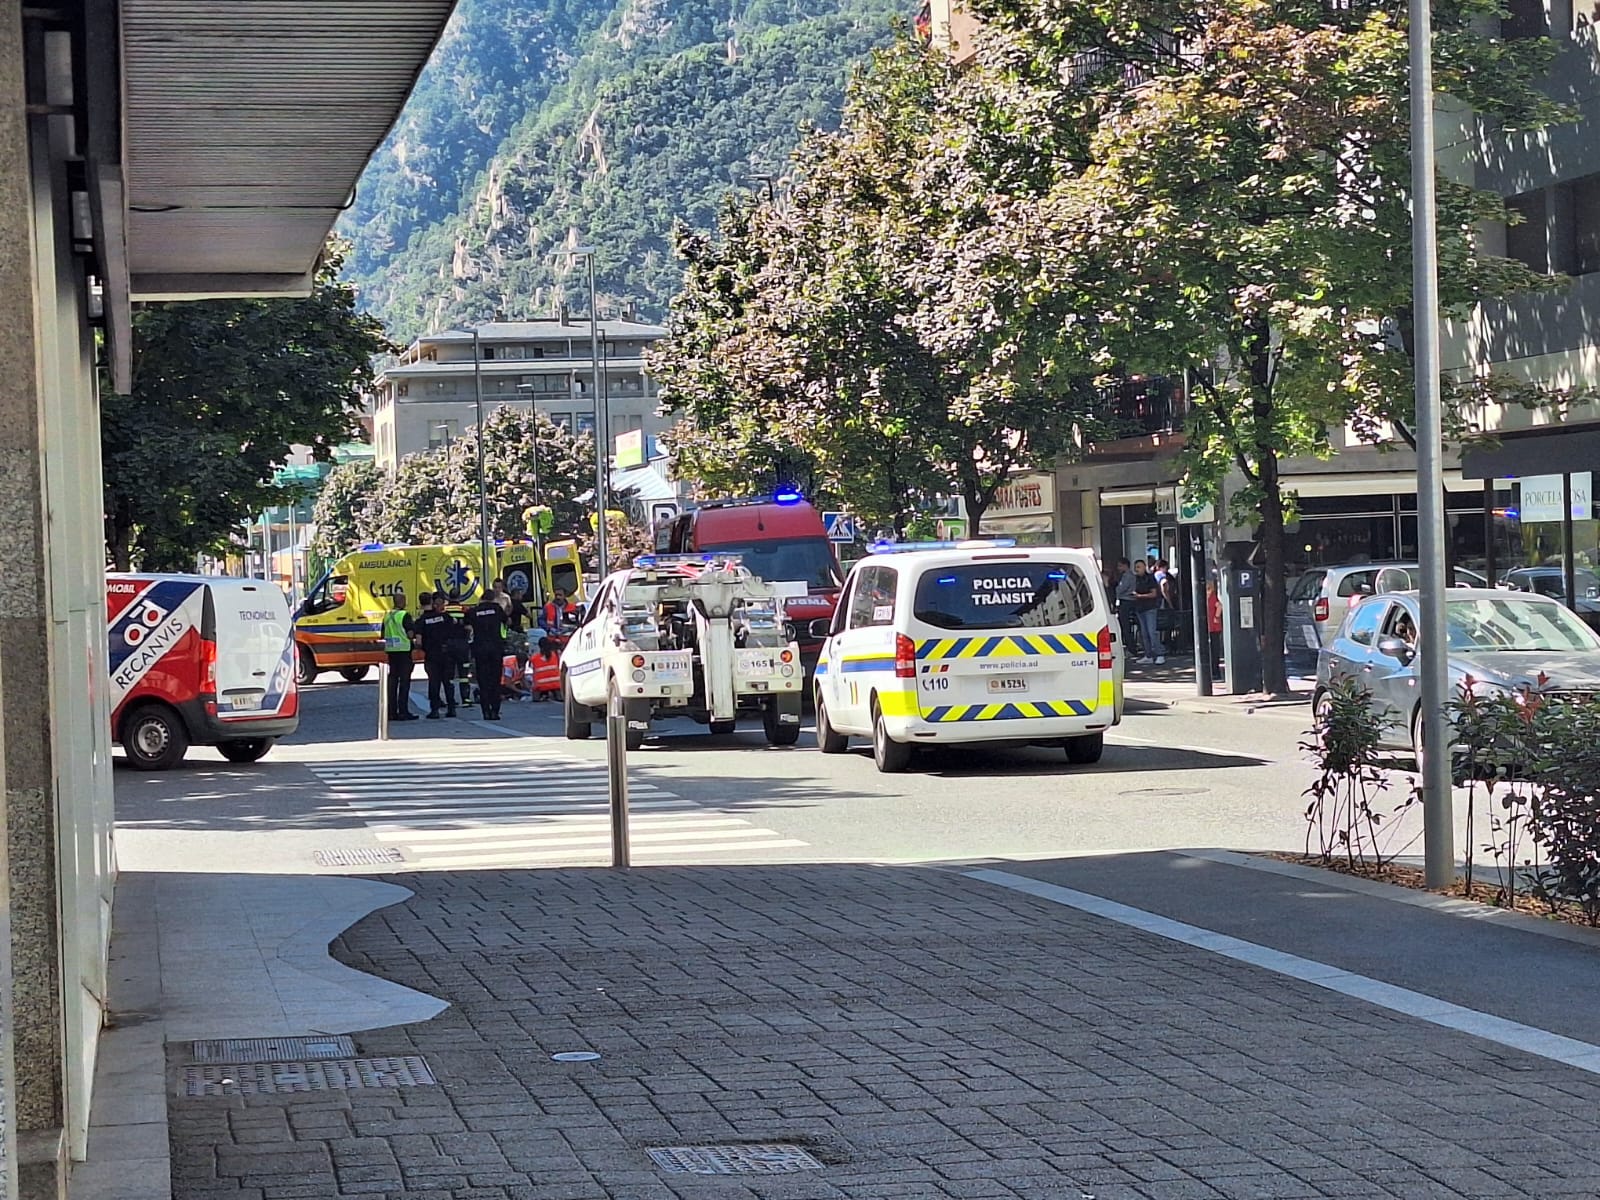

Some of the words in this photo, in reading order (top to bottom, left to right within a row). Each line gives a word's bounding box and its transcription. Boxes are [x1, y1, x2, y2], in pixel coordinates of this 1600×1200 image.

[1525, 489, 1586, 506] PORCELAOSA
[973, 577, 1032, 590] POLICIA
[1241, 573, 1250, 585] P
[107, 584, 136, 593] MOBIL
[379, 580, 404, 597] 116
[971, 591, 1036, 605] TRÀNSIT
[115, 618, 184, 690] RECANVIS
[980, 660, 1039, 669] www.policia.ad
[930, 678, 949, 690] 110
